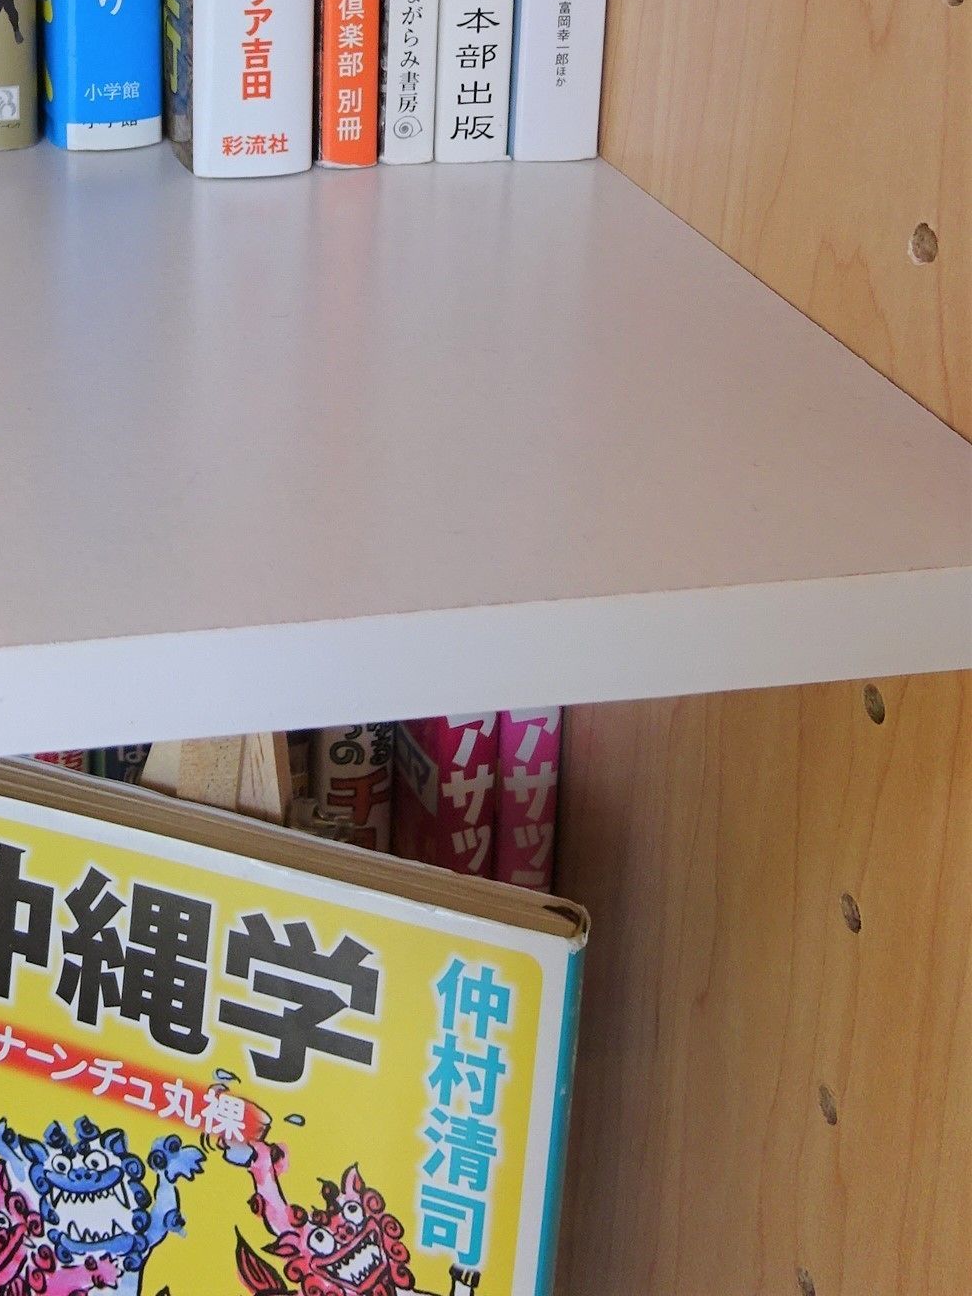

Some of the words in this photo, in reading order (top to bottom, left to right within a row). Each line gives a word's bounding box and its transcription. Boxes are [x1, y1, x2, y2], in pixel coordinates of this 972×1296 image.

[83, 81, 141, 102] 小学館
[335, 87, 361, 141] 別冊
[220, 134, 290, 157] 彩流社
[419, 955, 512, 1267] 仲村清司
